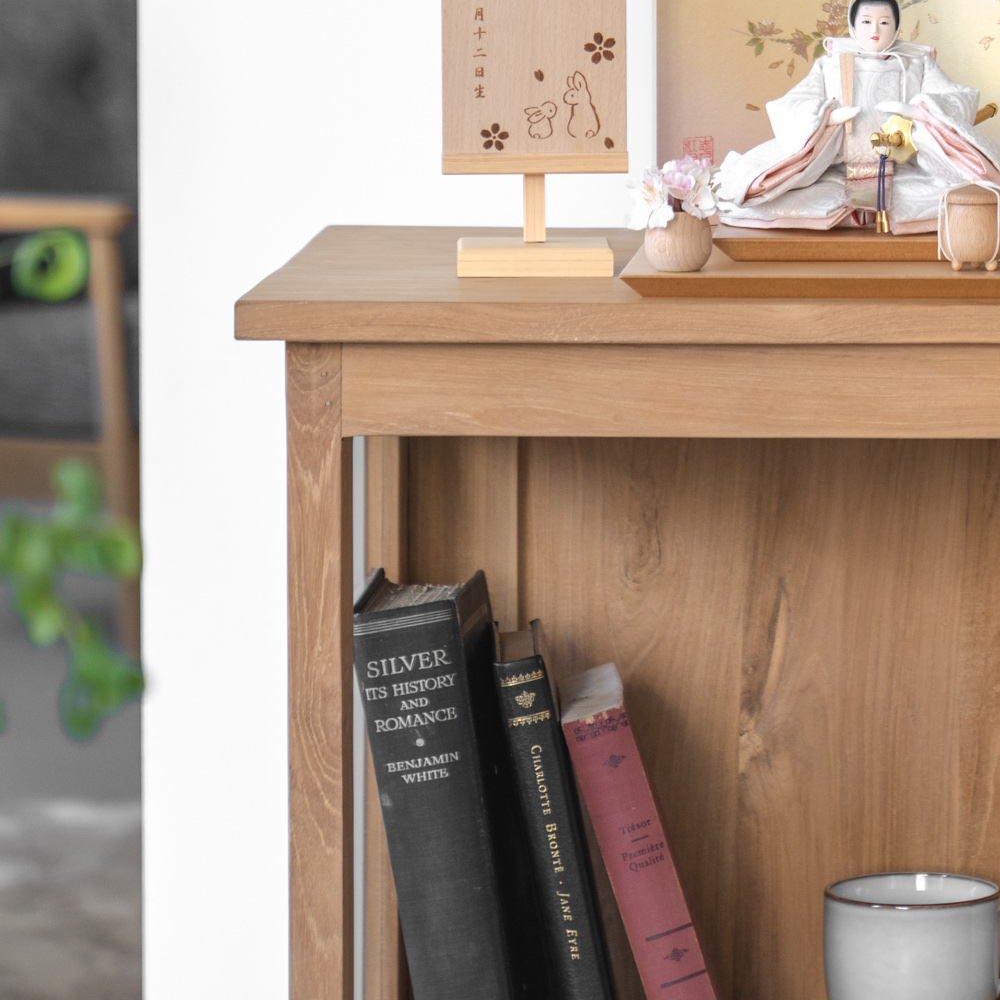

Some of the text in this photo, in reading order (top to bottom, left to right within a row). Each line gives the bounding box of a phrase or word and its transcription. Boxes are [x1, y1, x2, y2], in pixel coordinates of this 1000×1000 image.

[366, 648, 453, 679] SILVER
[364, 672, 457, 701] ITS HISTORY
[399, 697, 429, 711] AND
[374, 706, 458, 733] ROMANCE
[386, 751, 460, 773] BENJAMIN
[401, 767, 449, 784] WHITE
[618, 818, 651, 835] Trésor
[530, 744, 552, 816] CHARLOTTE
[556, 890, 573, 922] JANE
[566, 928, 580, 960] EYRE
[621, 841, 665, 861] Première
[629, 852, 665, 872] Qualité
